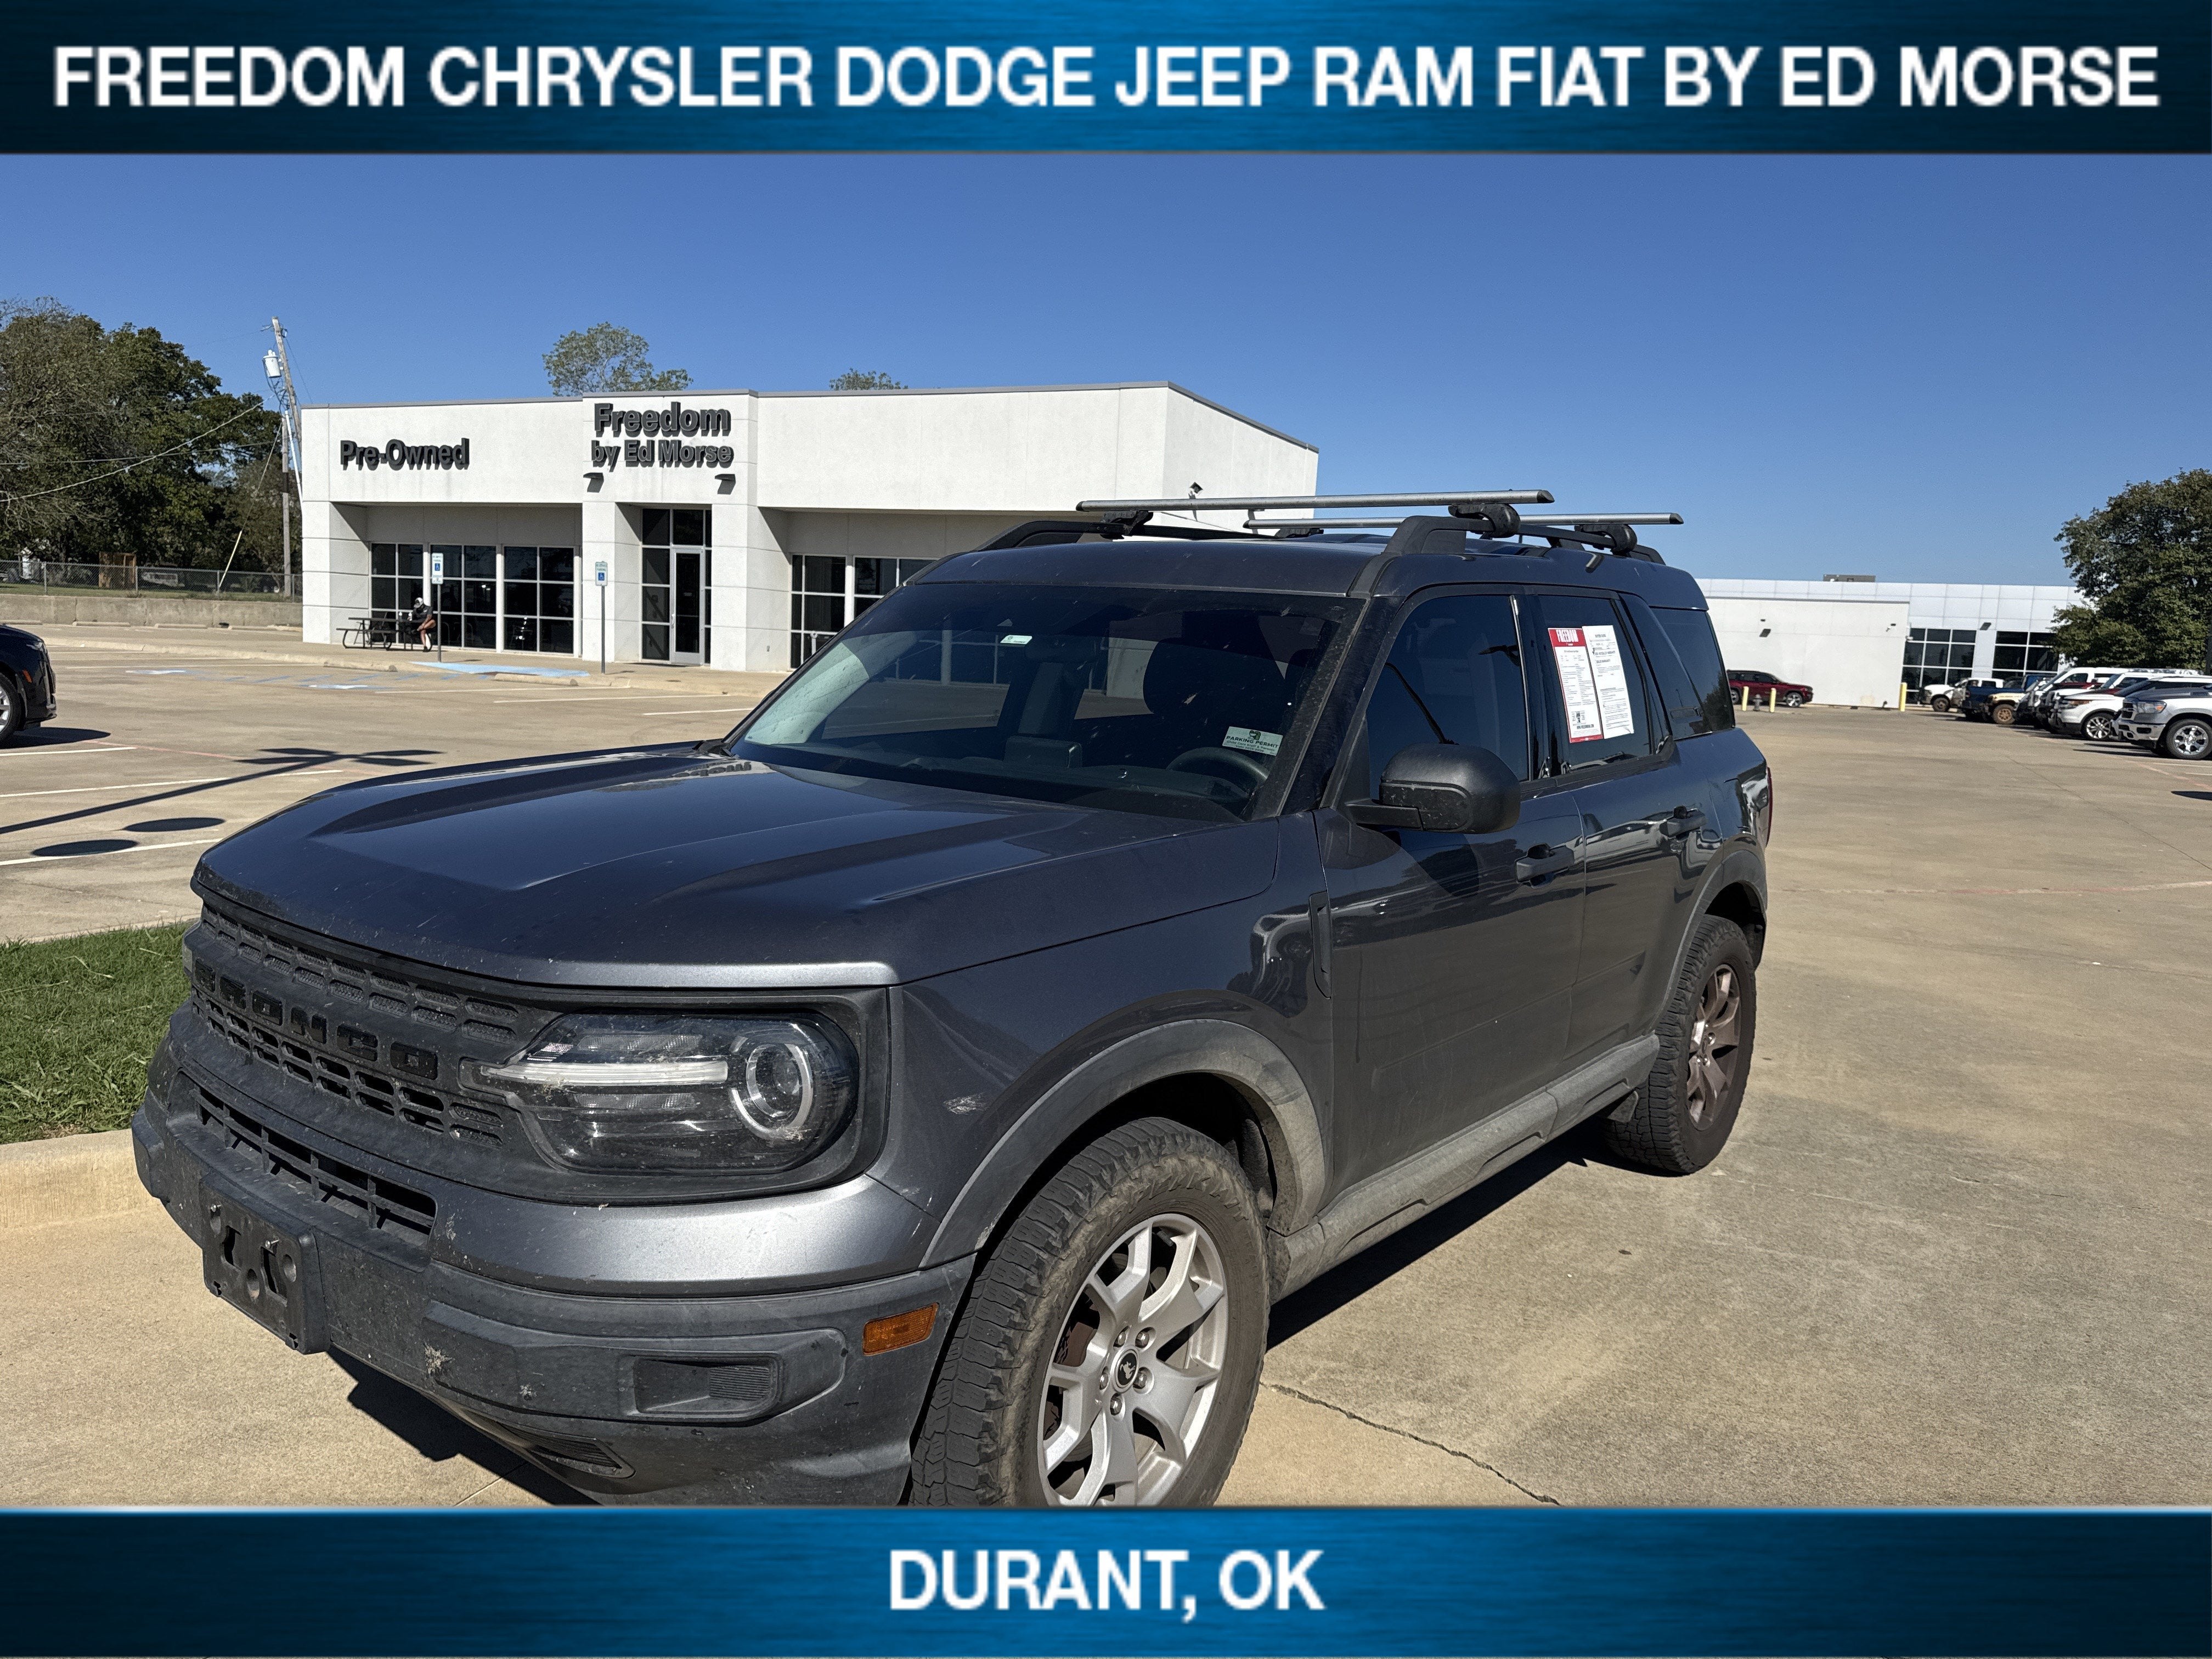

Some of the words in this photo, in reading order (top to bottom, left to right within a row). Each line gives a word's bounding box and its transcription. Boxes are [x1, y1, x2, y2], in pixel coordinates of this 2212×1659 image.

[594, 401, 731, 437] Freedom
[340, 438, 470, 470] Pre-Owned
[591, 440, 620, 472] by
[624, 439, 654, 468] Ed
[657, 439, 734, 469] Morse
[194, 958, 439, 1080] BRONCO
